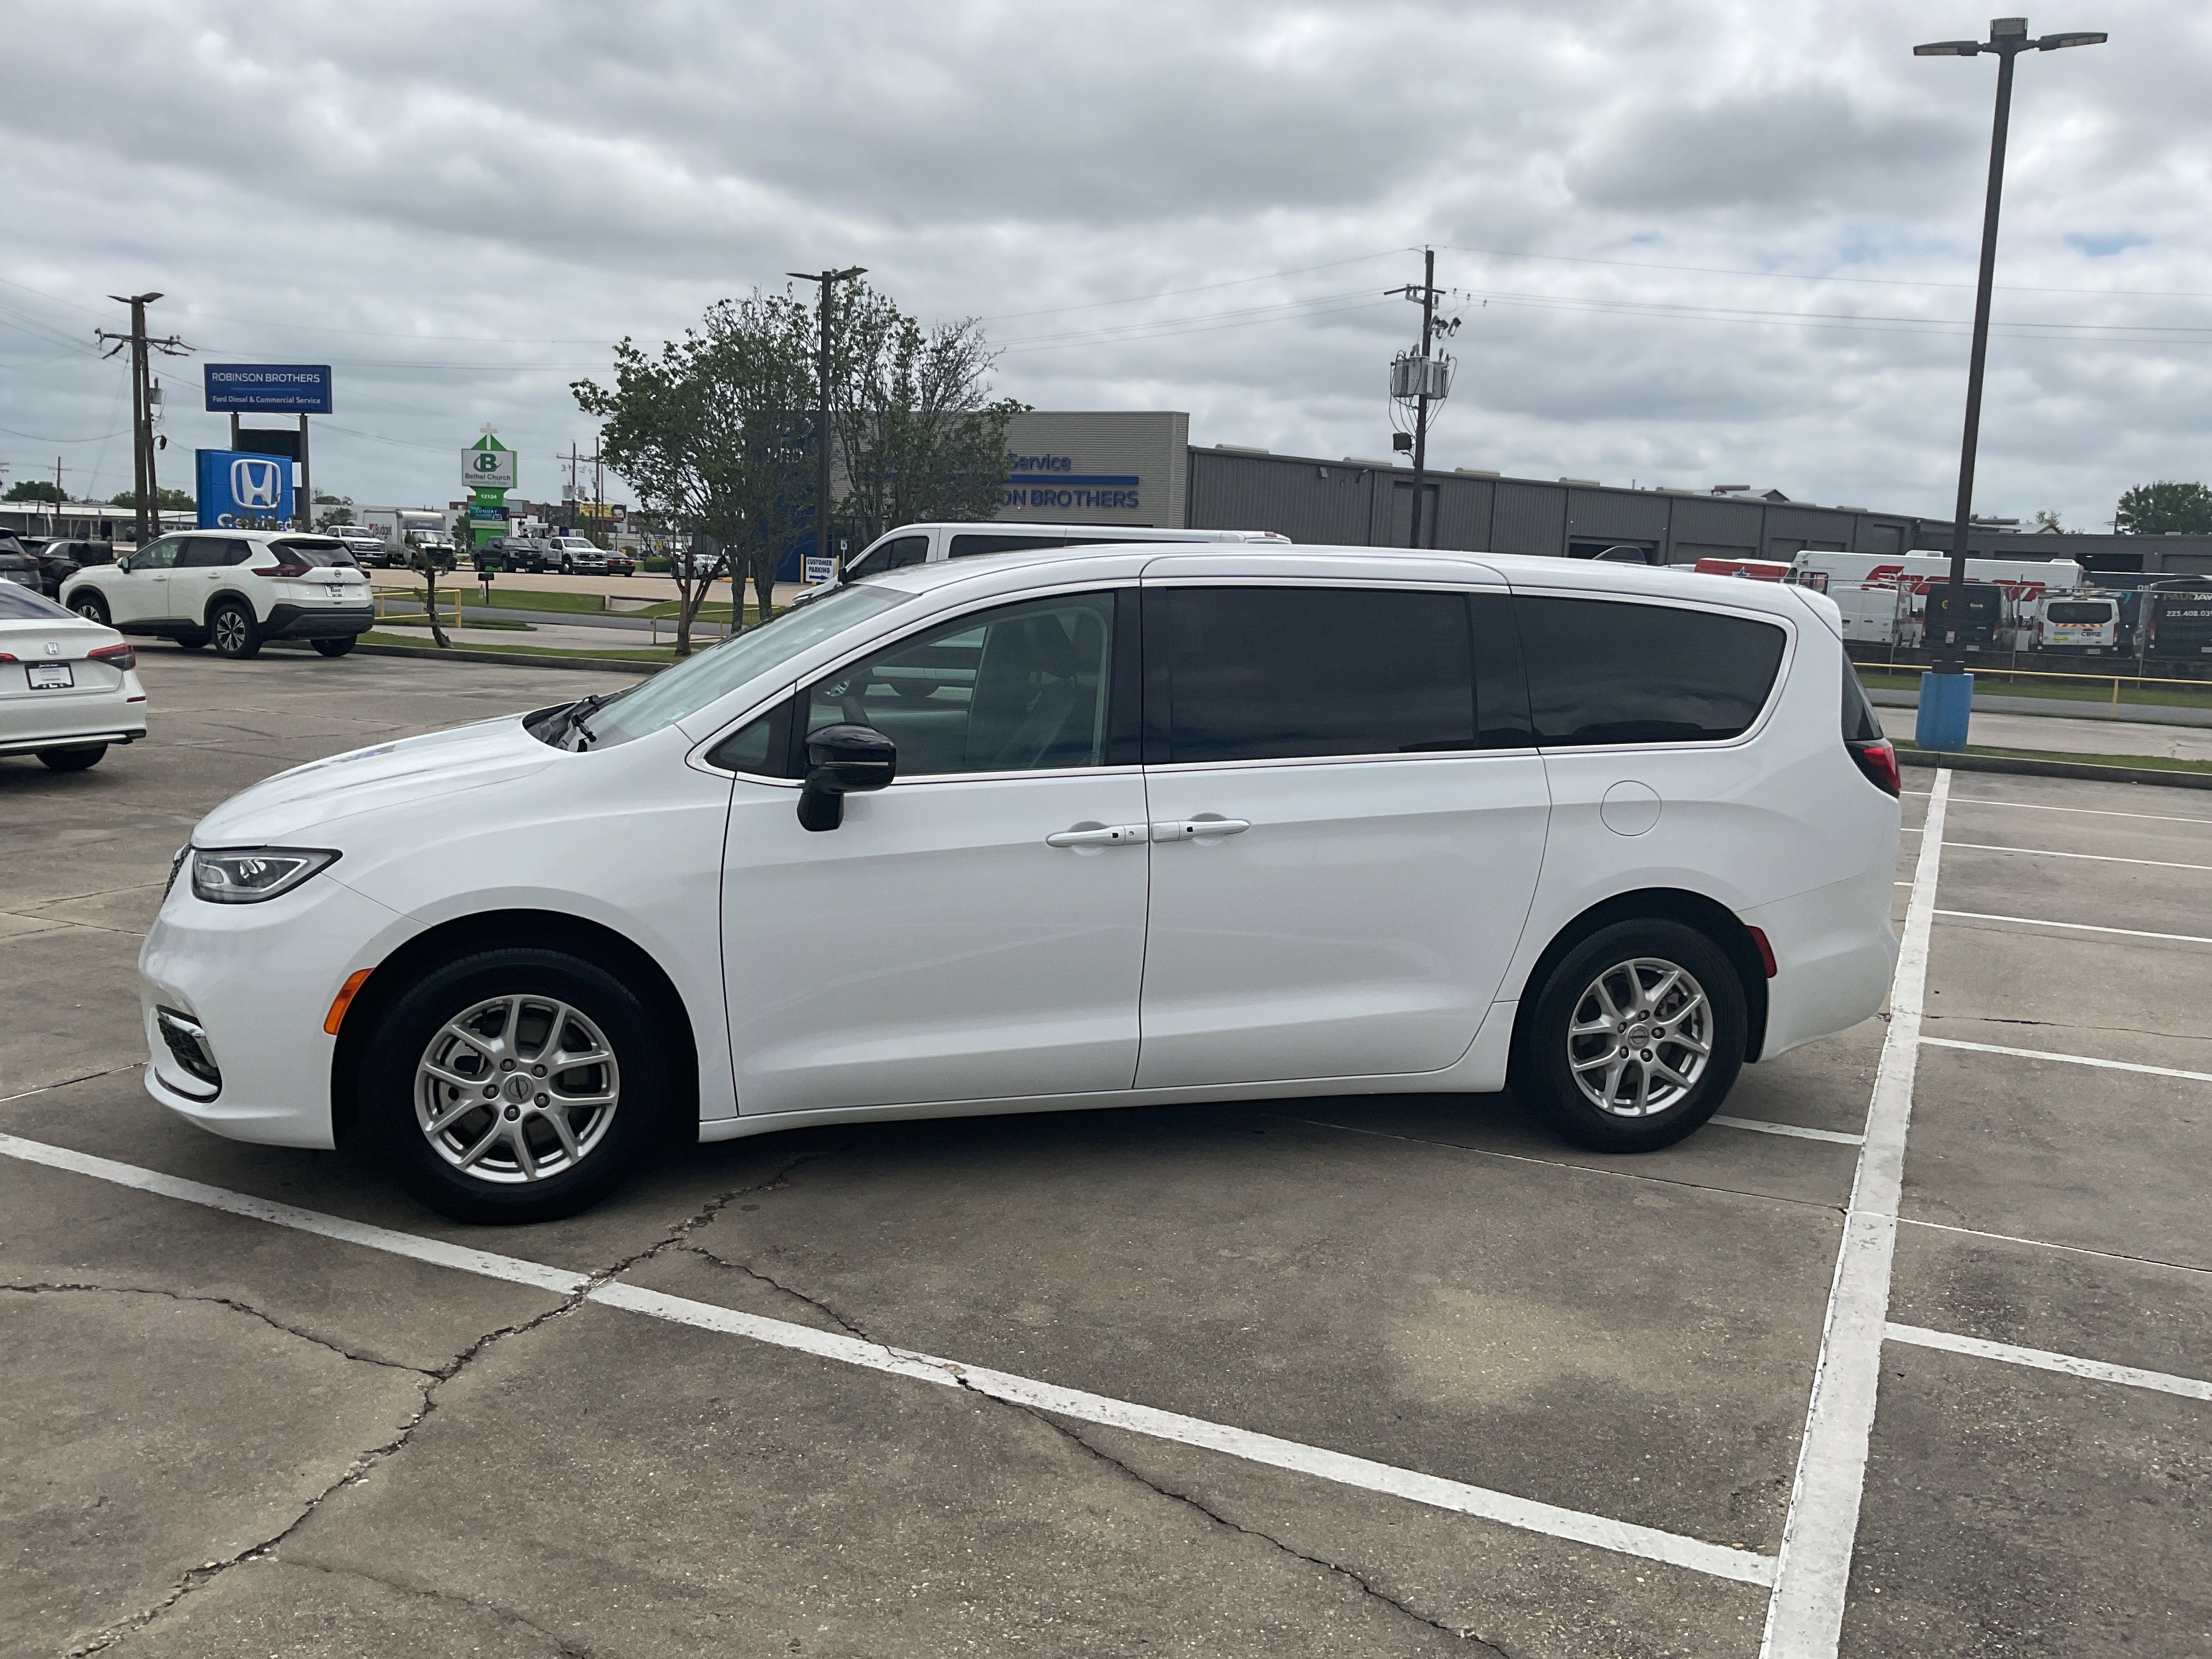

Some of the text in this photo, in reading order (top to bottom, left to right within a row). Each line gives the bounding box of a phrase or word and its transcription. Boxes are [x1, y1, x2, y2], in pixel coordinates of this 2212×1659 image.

[212, 373, 320, 382] ROBINSON BROTHERS
[480, 453, 498, 472] B
[1007, 453, 1071, 470] Service
[1030, 489, 1139, 508] BROTHERS
[375, 523, 392, 539] Budget
